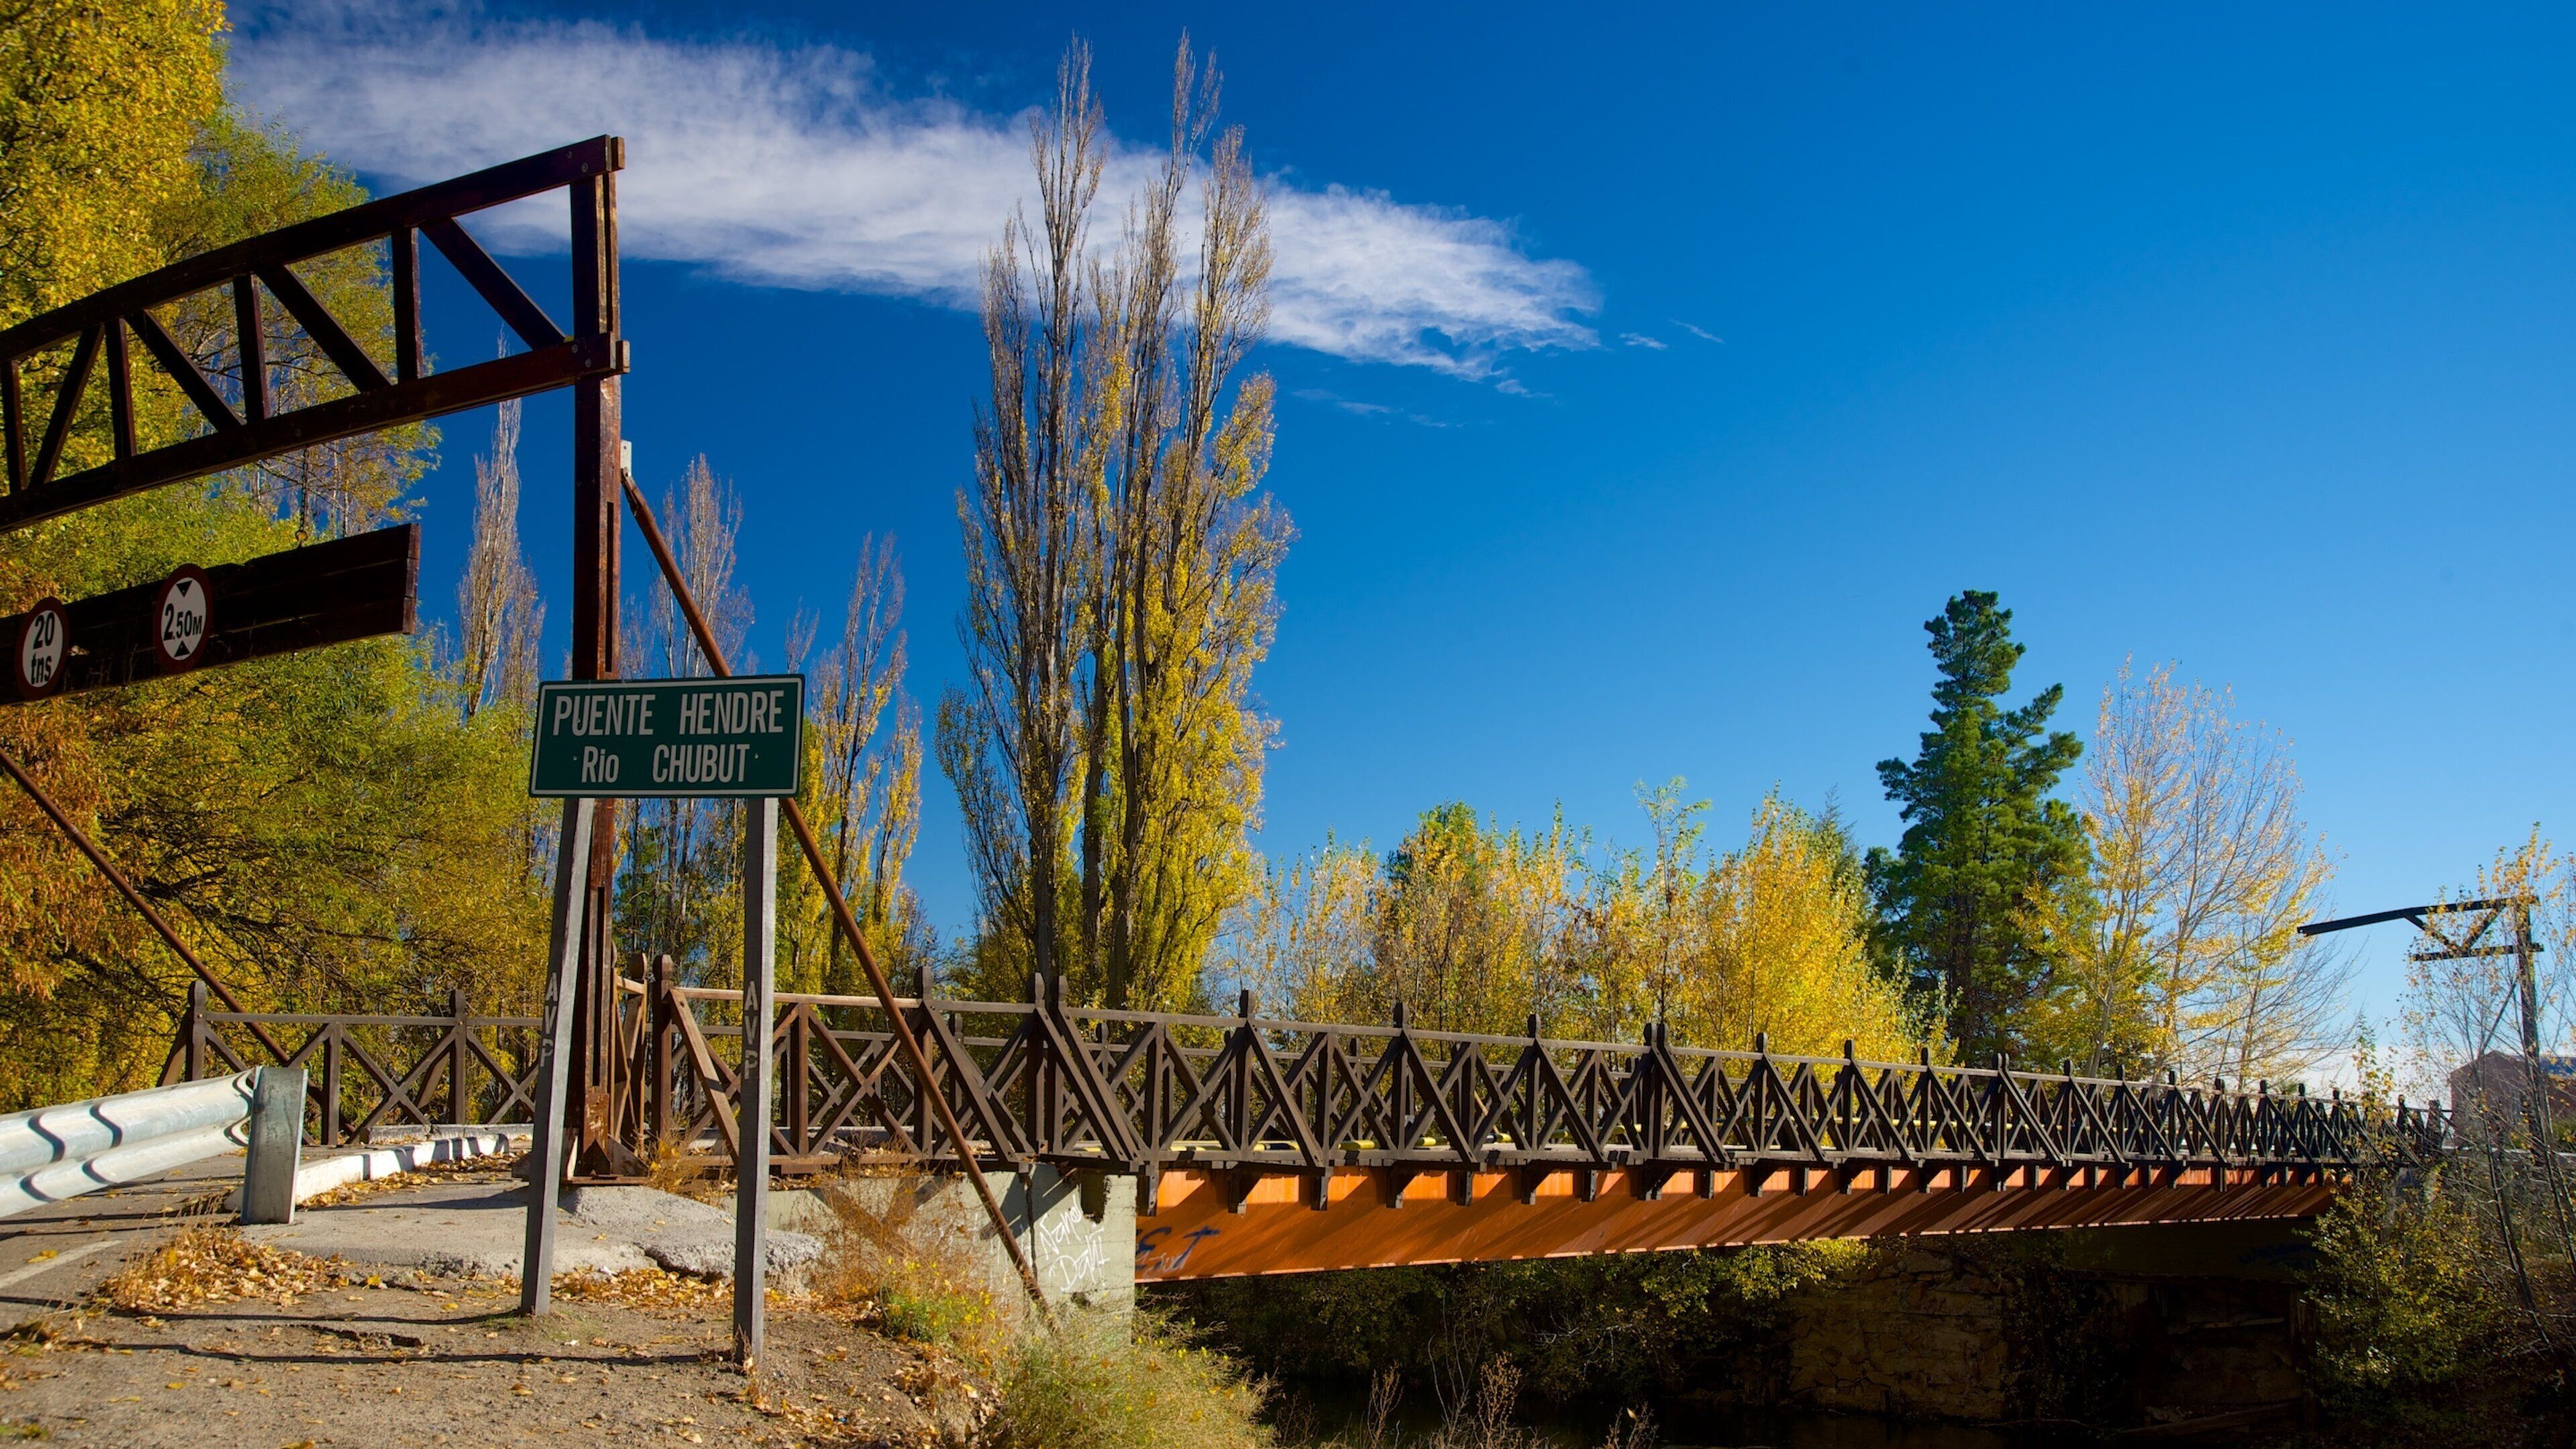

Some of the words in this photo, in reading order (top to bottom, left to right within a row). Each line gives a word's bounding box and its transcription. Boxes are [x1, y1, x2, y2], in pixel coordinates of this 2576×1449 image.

[32, 611, 55, 650] 20
[31, 652, 52, 685] tns
[553, 694, 656, 737] PUENTE
[679, 690, 784, 735] HENDRE
[581, 745, 619, 784] Rio
[652, 743, 750, 784] CHUBUT
